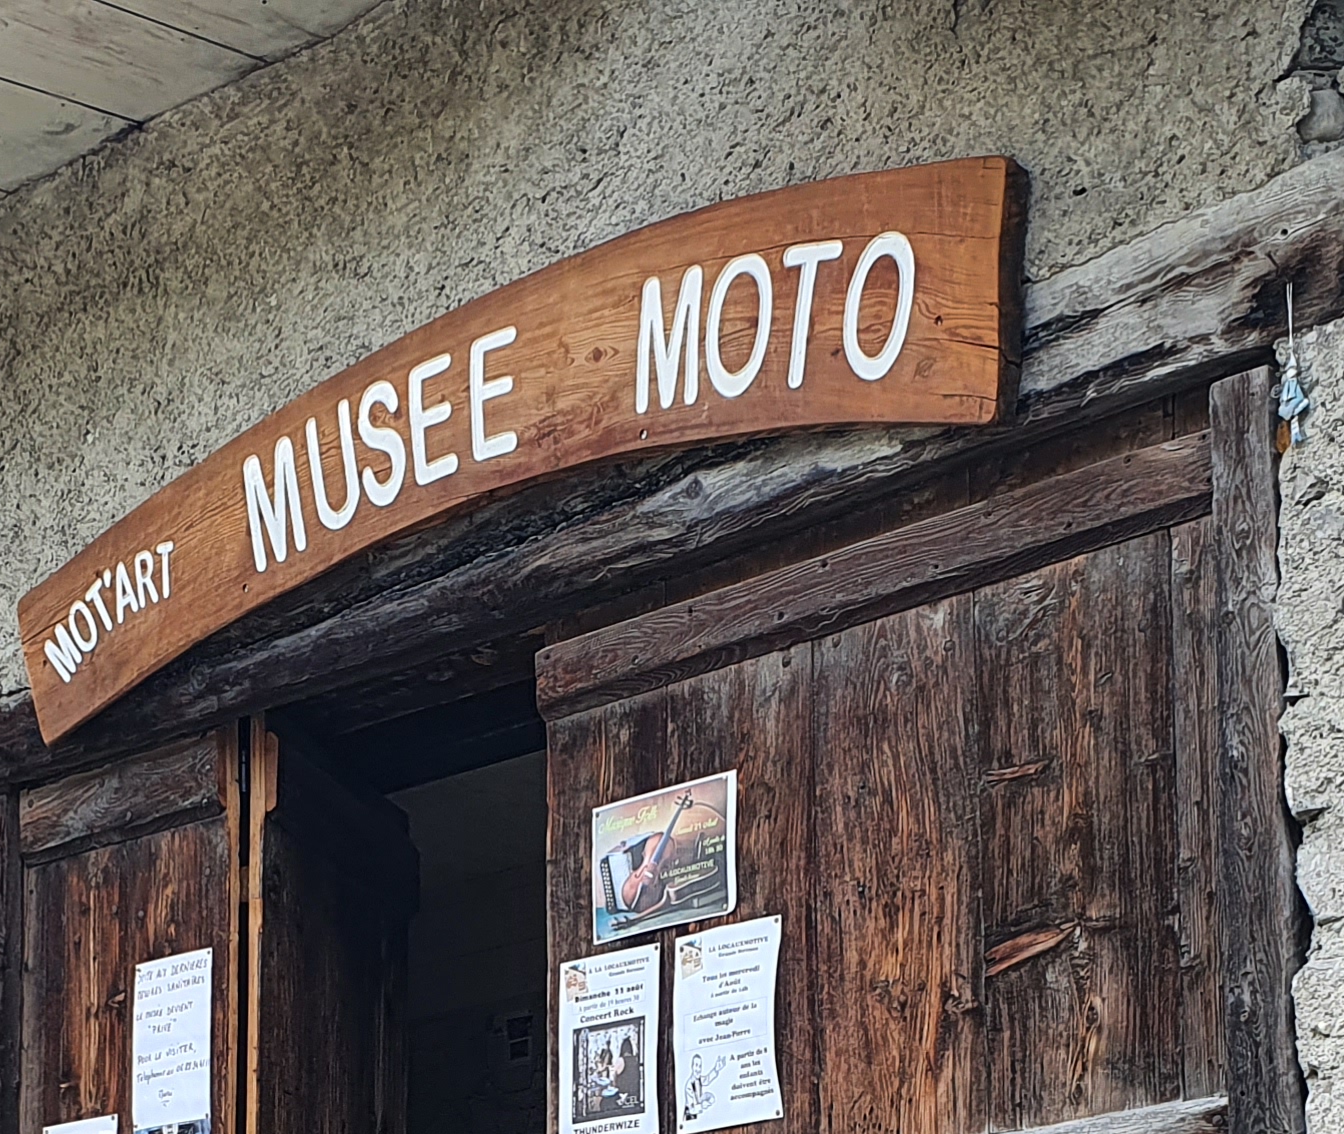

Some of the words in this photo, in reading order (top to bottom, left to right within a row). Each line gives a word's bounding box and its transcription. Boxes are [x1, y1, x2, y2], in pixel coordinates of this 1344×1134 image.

[41, 539, 176, 685] MOT'ART
[241, 325, 519, 573] MUSEE
[634, 230, 916, 415] MOTO
[574, 990, 610, 1003] Dimanche
[580, 1012, 612, 1024] Concert
[614, 1006, 634, 1018] Rock
